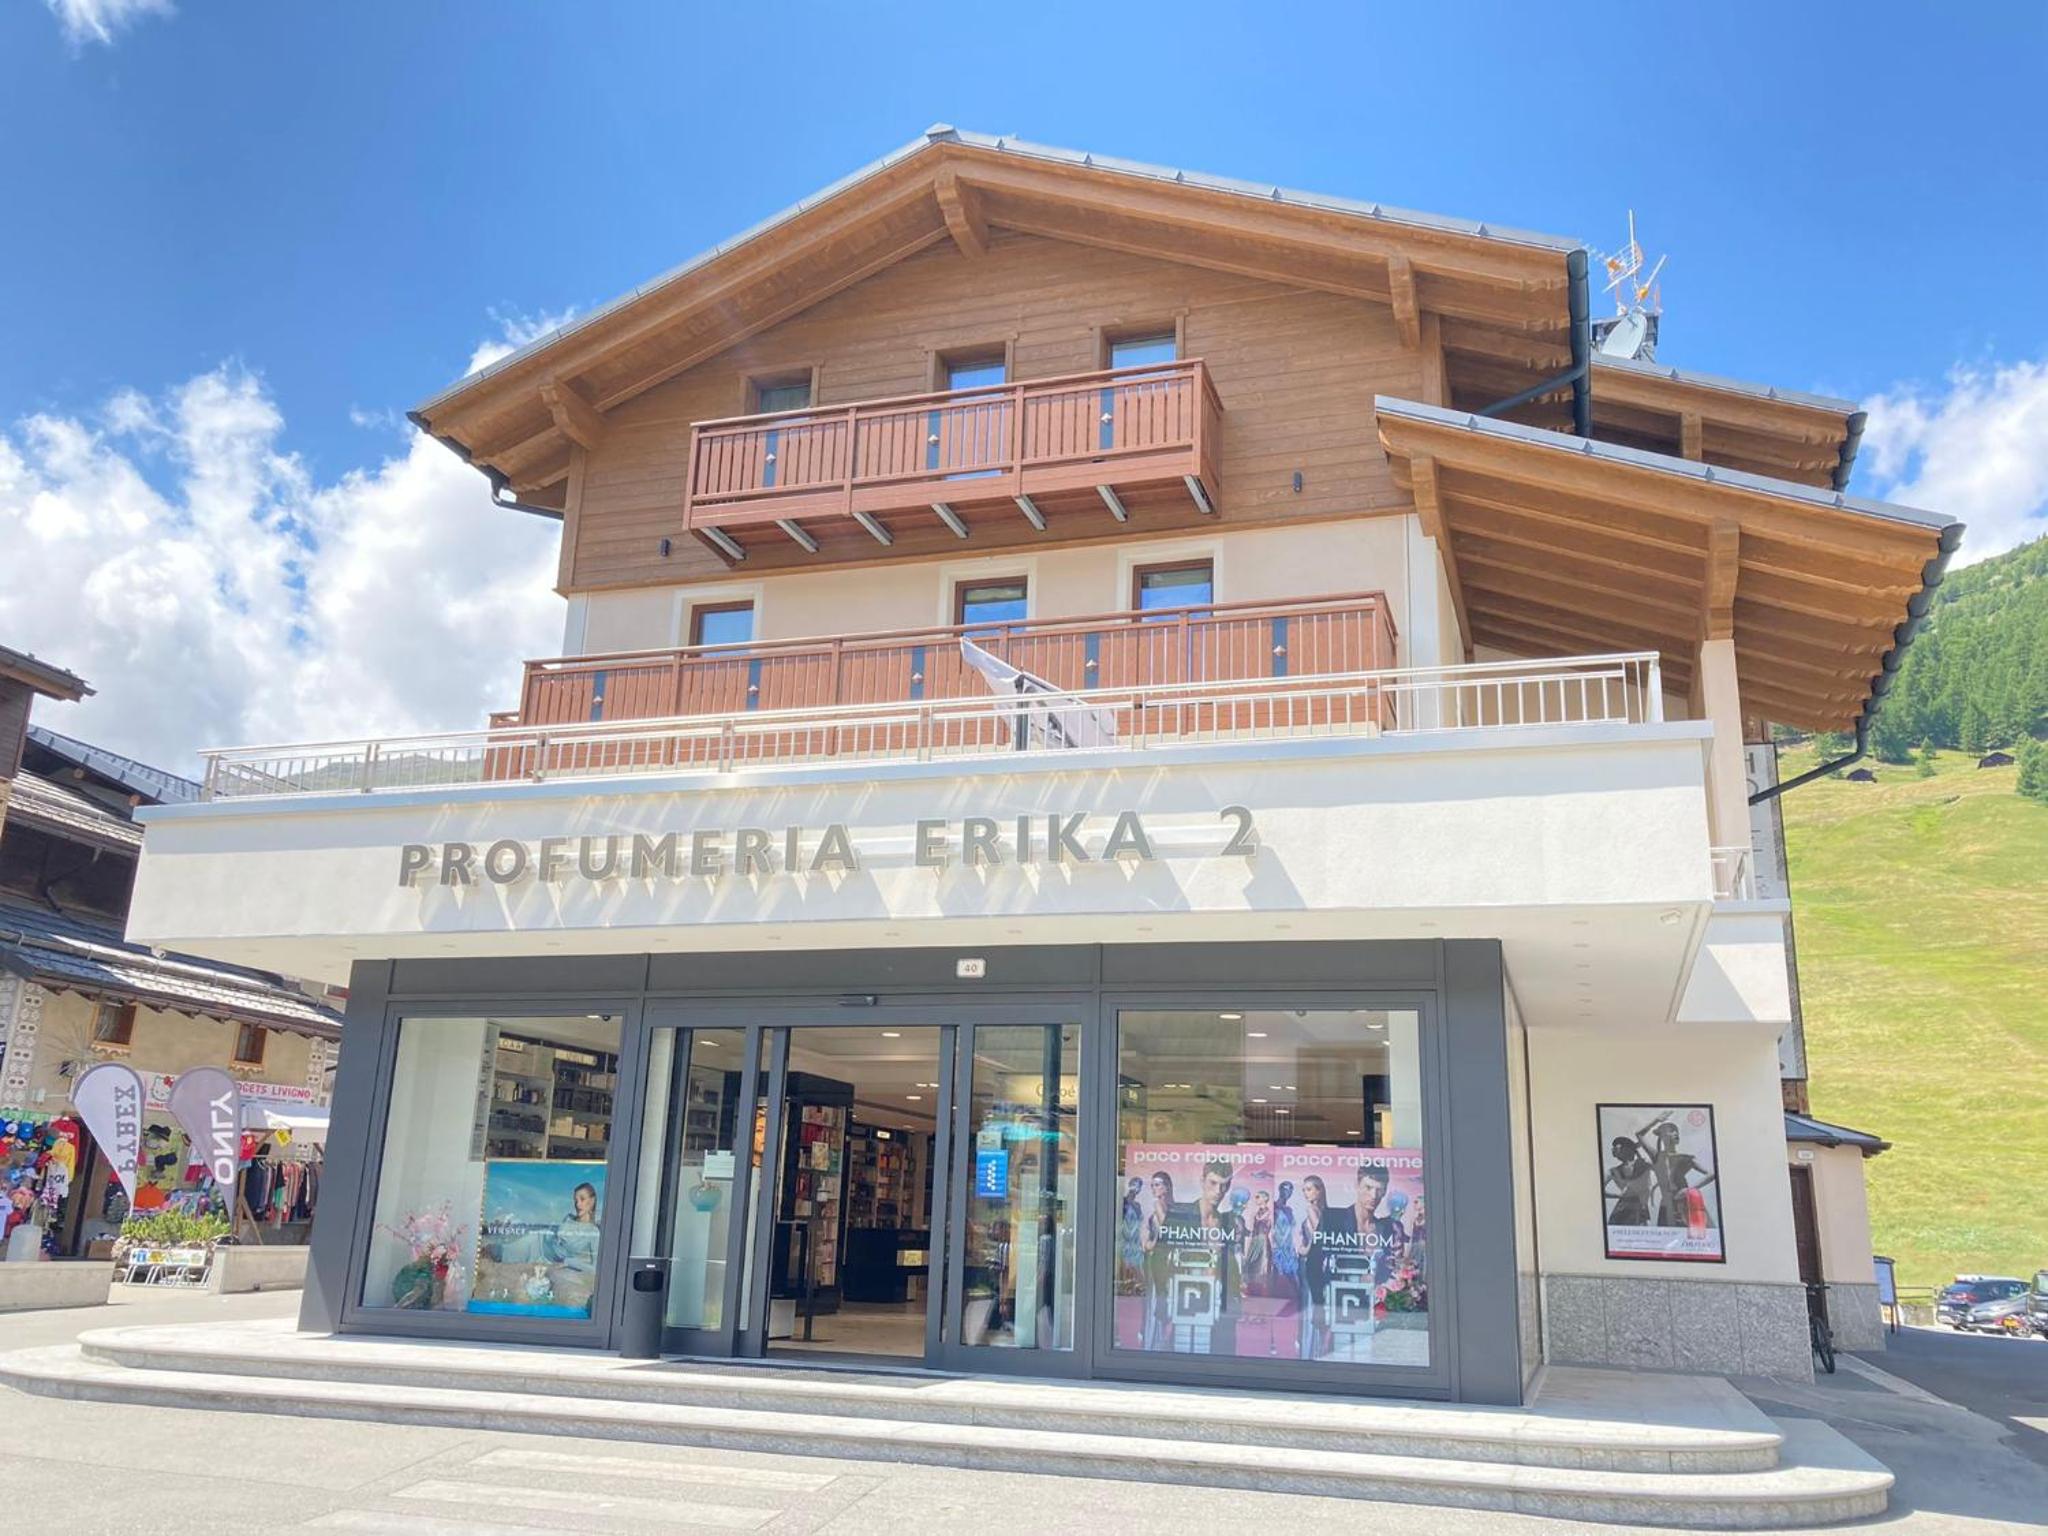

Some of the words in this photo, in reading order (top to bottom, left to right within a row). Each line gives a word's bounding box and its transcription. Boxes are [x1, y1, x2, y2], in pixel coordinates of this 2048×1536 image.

[399, 824, 857, 887] PROFUMERIA
[915, 810, 1154, 867] ERIKA
[1220, 805, 1257, 857] 2
[271, 1084, 311, 1099] LIVIGNO
[1134, 1150, 1180, 1164] paco
[1185, 1150, 1266, 1164] rabanne
[1283, 1154, 1332, 1168] paco
[1337, 1153, 1423, 1168] rabanne
[1159, 1225, 1235, 1241] PHANTOM
[1312, 1231, 1394, 1247] PHANTOM
